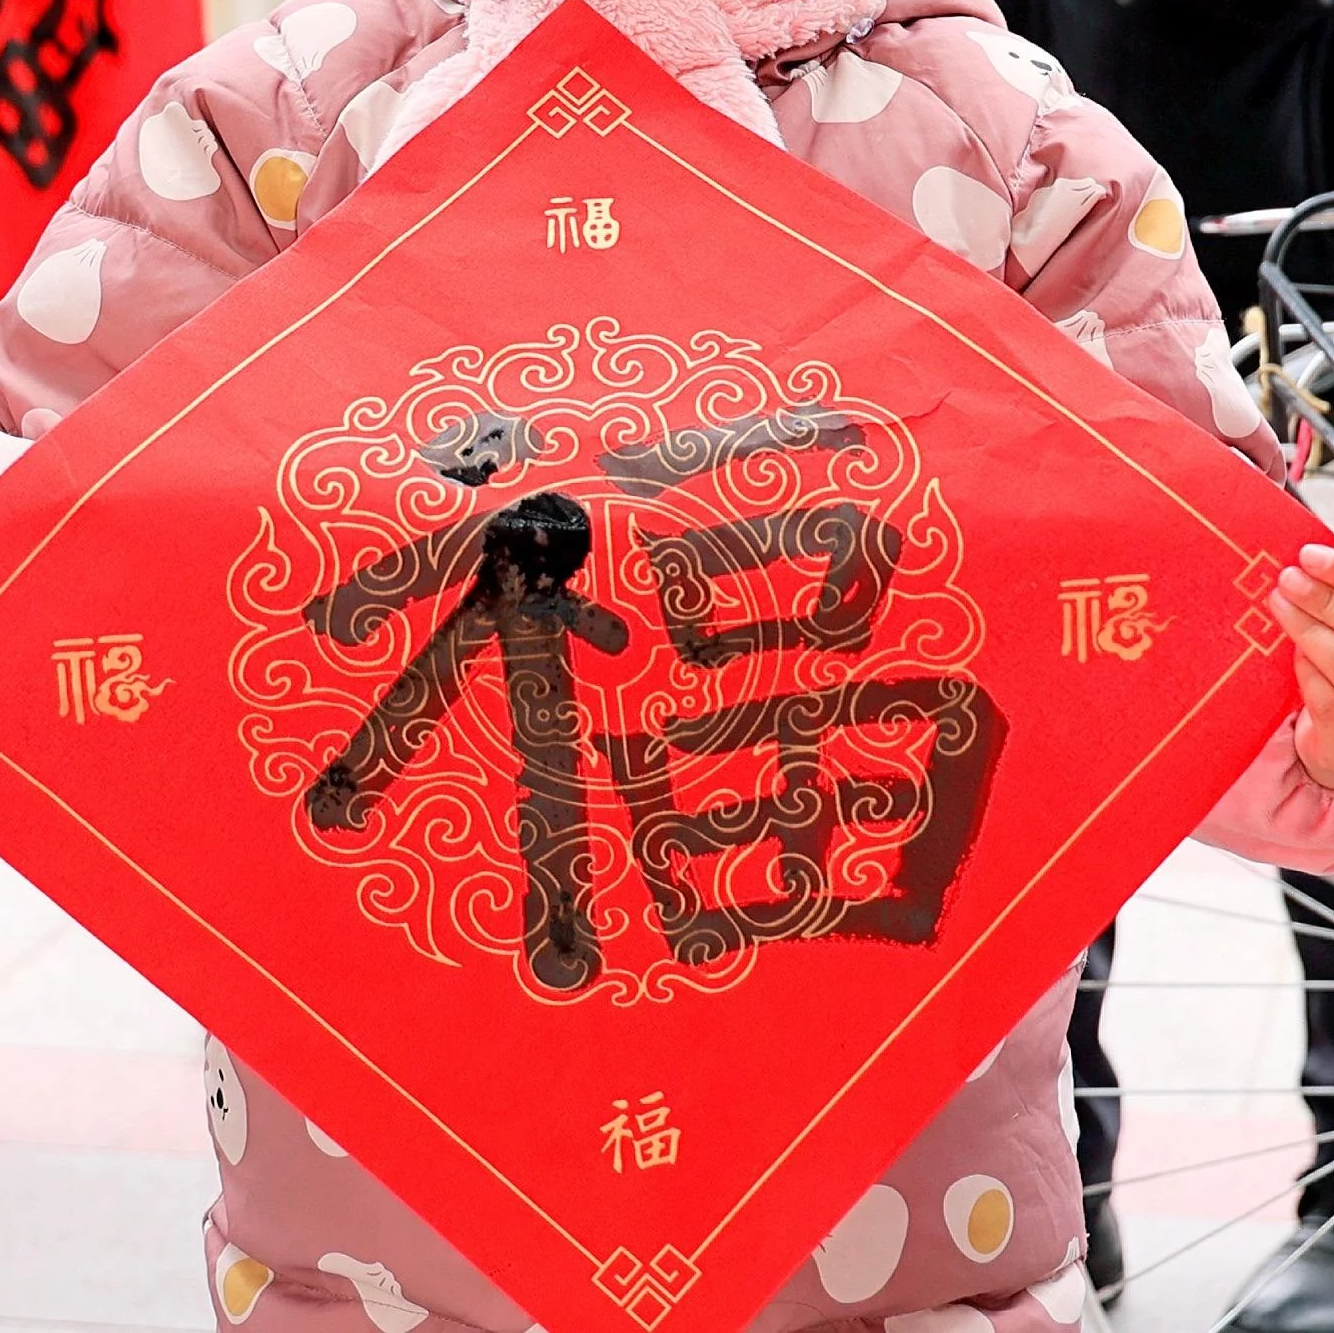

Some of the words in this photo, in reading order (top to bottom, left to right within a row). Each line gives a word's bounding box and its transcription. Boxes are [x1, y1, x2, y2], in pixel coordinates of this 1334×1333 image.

[543, 196, 621, 255] 福
[1057, 573, 1177, 664] 福
[50, 633, 176, 725] 福
[302, 400, 1012, 992] 福
[599, 1090, 682, 1174] 福
